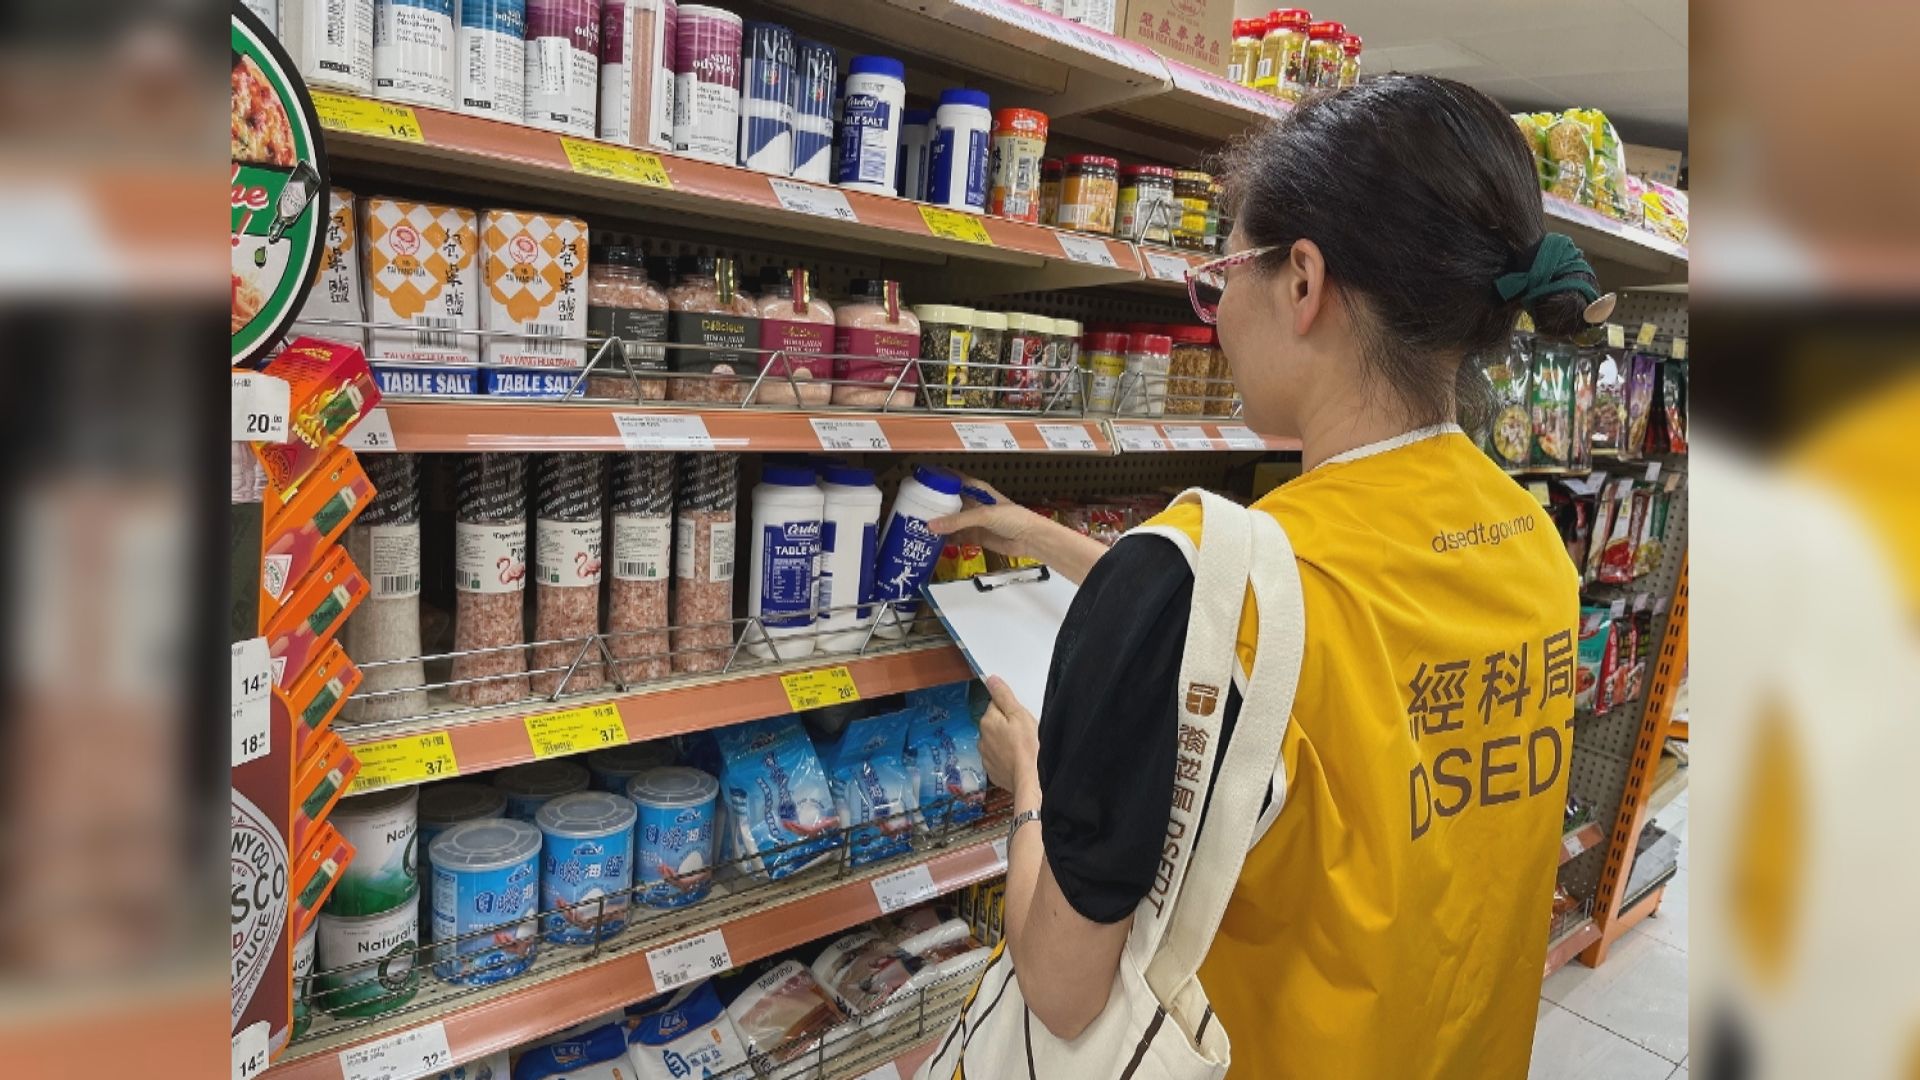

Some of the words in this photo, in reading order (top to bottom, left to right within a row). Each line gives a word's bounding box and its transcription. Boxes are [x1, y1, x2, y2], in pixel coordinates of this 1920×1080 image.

[862, 116, 885, 127] SALT
[382, 372, 433, 393] TABLE
[436, 373, 472, 394] SALT
[497, 374, 541, 393] TABLE
[544, 376, 579, 395] SALT
[248, 414, 270, 433] 20
[292, 423, 319, 449] HOT
[1432, 513, 1535, 553] dsedt.gov.mo
[774, 546, 807, 556] TABLE
[902, 548, 926, 562] SALT
[903, 538, 932, 556] TABLE
[241, 674, 260, 695] 14
[1408, 628, 1574, 743] 經科局
[241, 734, 258, 756] 18
[600, 728, 615, 742] 37
[425, 760, 443, 775] 37
[1147, 819, 1186, 919] DSEDT
[235, 912, 271, 978] AUCE
[357, 927, 411, 954] Natural
[709, 954, 723, 970] 38
[240, 1055, 257, 1077] 14
